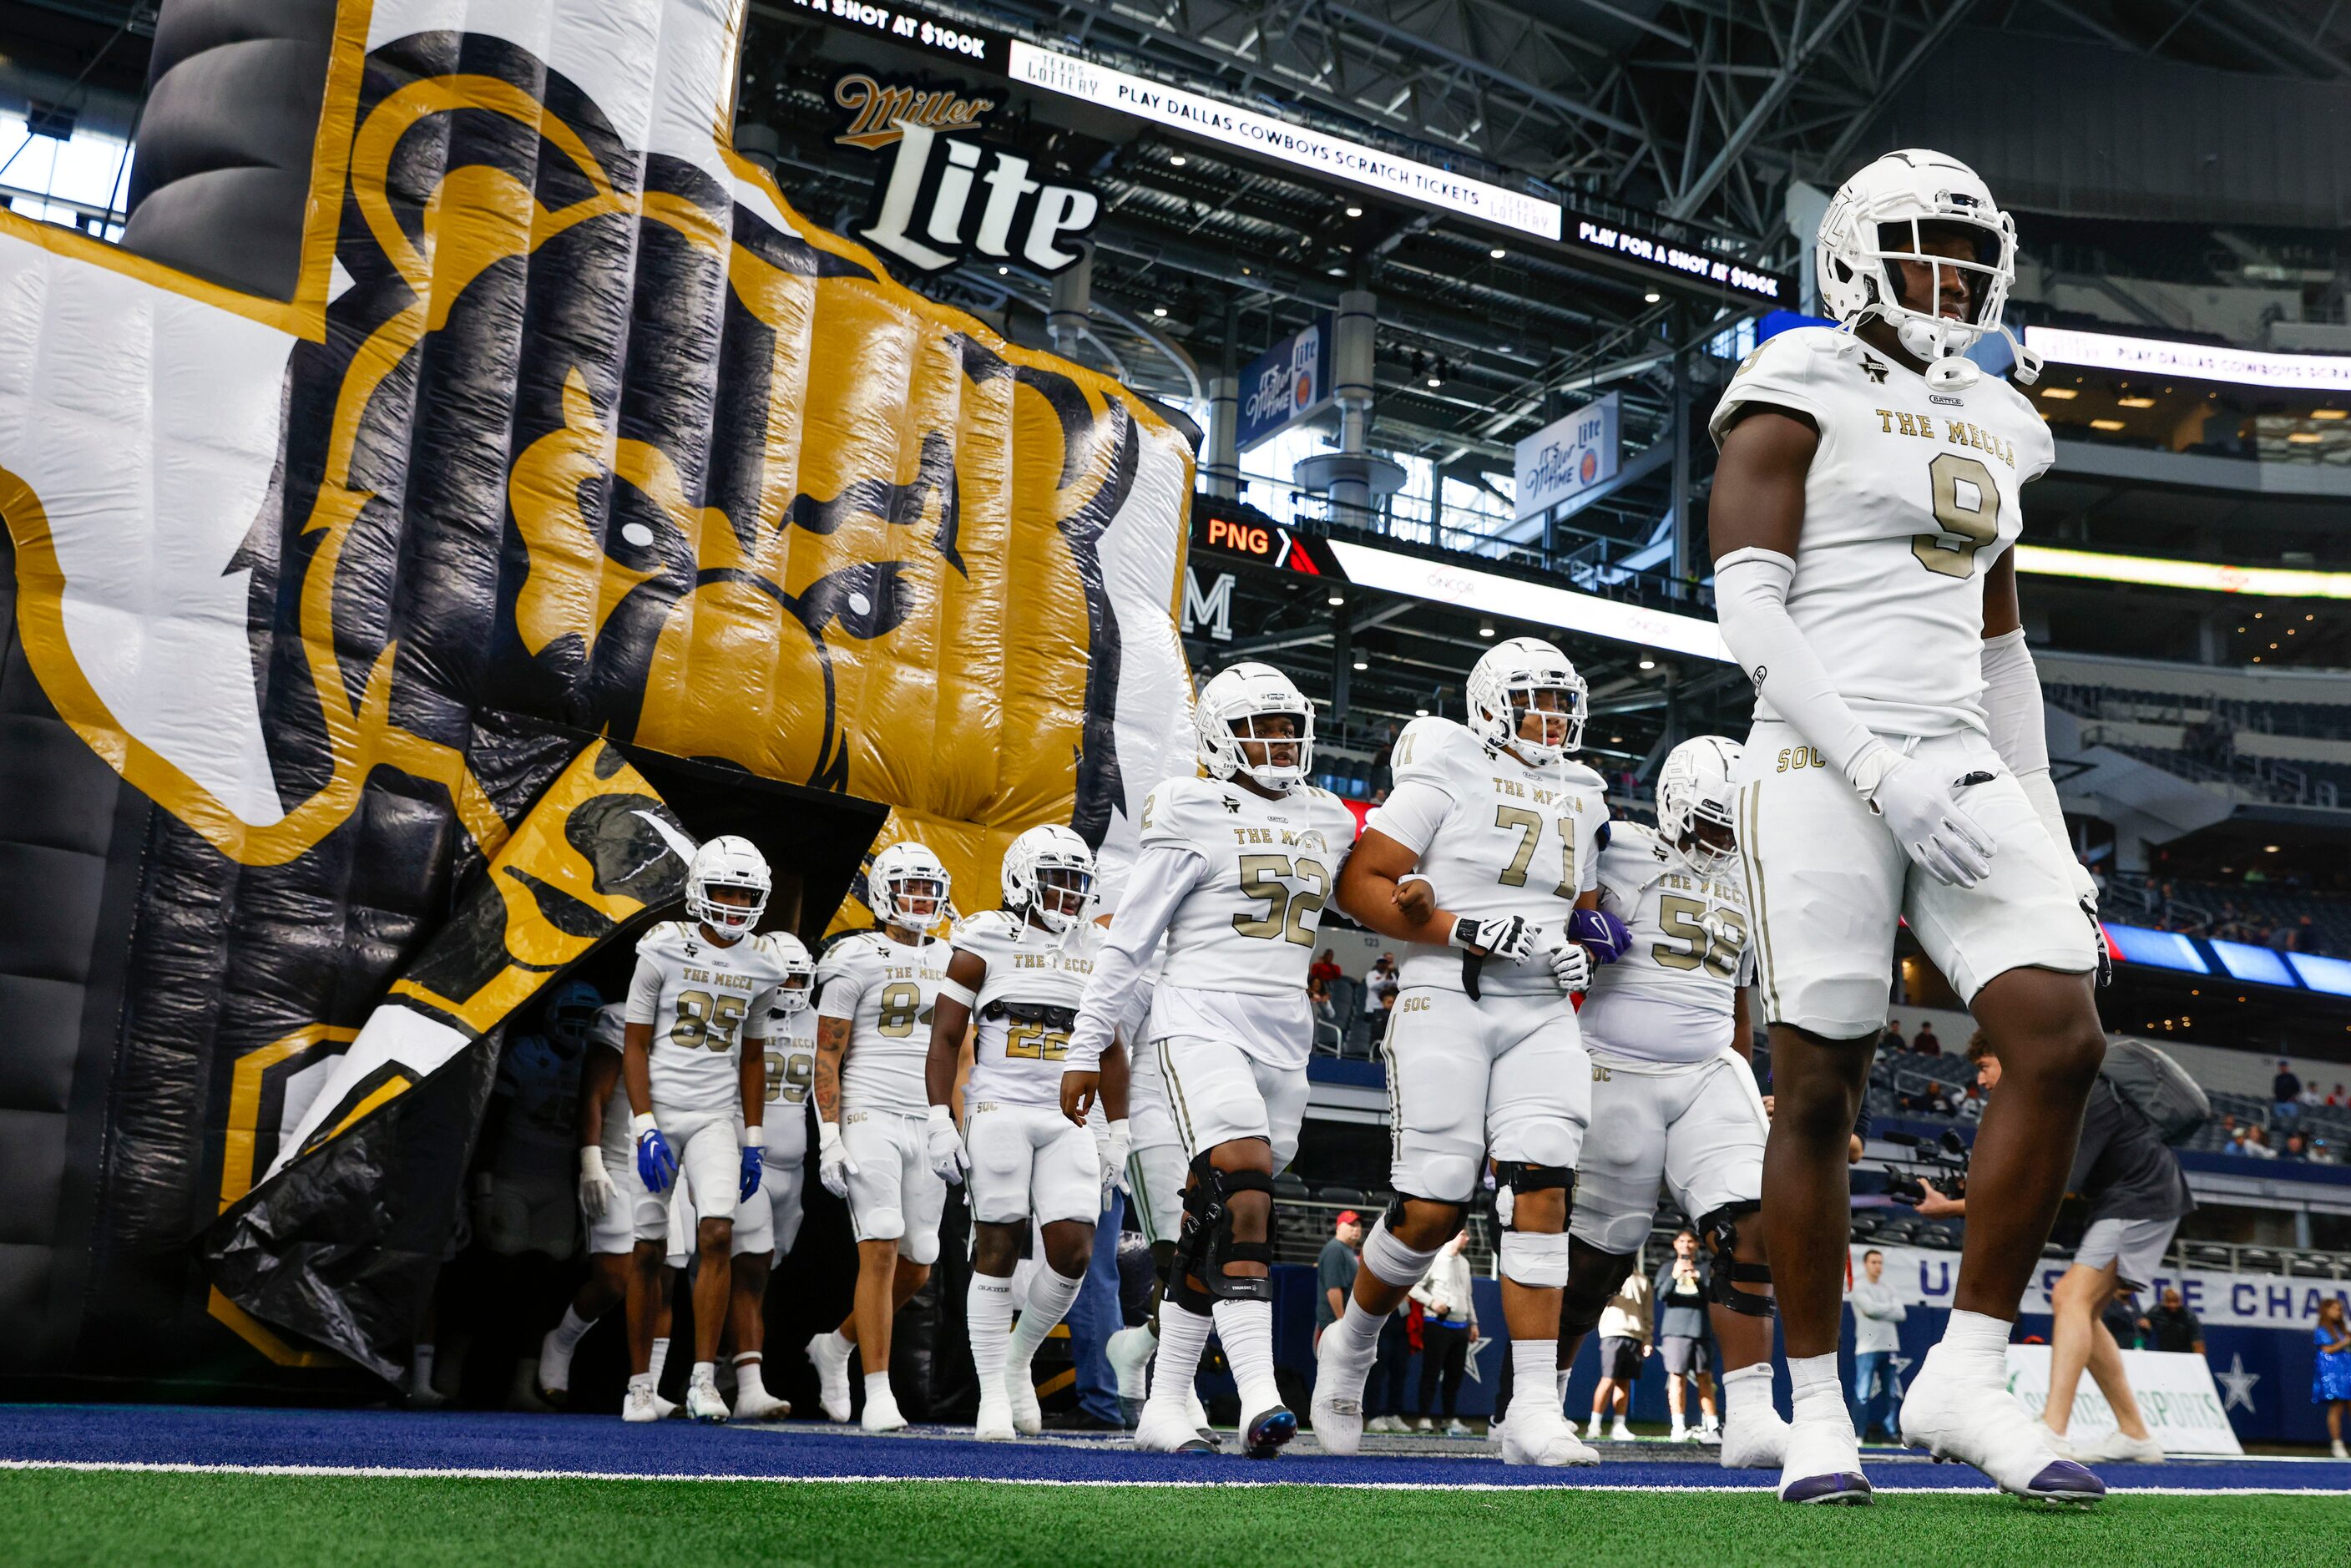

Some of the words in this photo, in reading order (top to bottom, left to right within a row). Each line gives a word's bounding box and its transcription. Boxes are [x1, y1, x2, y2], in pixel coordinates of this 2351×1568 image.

[832, 0, 889, 29] SHOT
[892, 15, 918, 38] AT
[921, 21, 984, 58] $100K
[1028, 61, 1098, 95] LOTTERY
[835, 73, 994, 135] Miller
[1119, 85, 1160, 109] PLAY
[1167, 99, 1232, 130] DALLAS
[1240, 122, 1329, 159] COWBOYS
[1336, 151, 1409, 184] SCRATCH
[1415, 175, 1479, 205] TICKETS
[859, 118, 1099, 271] Lite
[1580, 222, 1618, 248] PLAY
[1620, 234, 1653, 260] FOR
[1654, 245, 1667, 264] A
[1668, 249, 1710, 276] SHOT
[1711, 262, 1731, 281] AT
[1731, 266, 1777, 297] $100K
[1295, 341, 1317, 372] Lite
[1933, 396, 1962, 405] BATTLE
[1579, 420, 1601, 449] Lite
[1876, 409, 1934, 438] THE
[1945, 420, 2015, 469] MECCA
[1911, 452, 2001, 579] 9
[1209, 518, 1268, 554] PNG
[1181, 565, 1236, 641] M
[1397, 733, 1416, 767] 71
[1493, 777, 1524, 797] THE
[1533, 788, 1583, 813] MEA
[1234, 829, 1273, 845] THE
[1495, 805, 1577, 901] 71
[1659, 873, 1691, 891] THE
[1231, 854, 1332, 948] 52
[1364, 937, 1380, 948] 123
[1651, 894, 1747, 979] 58
[885, 966, 912, 979] THE
[1014, 954, 1045, 968] THE
[683, 967, 710, 983] THE
[714, 973, 753, 990] MECCA
[670, 989, 746, 1052] 85
[1403, 997, 1430, 1012] SOC
[1591, 1068, 1611, 1082] OC
[847, 1111, 868, 1125] SOC
[977, 1101, 998, 1114] SOC
